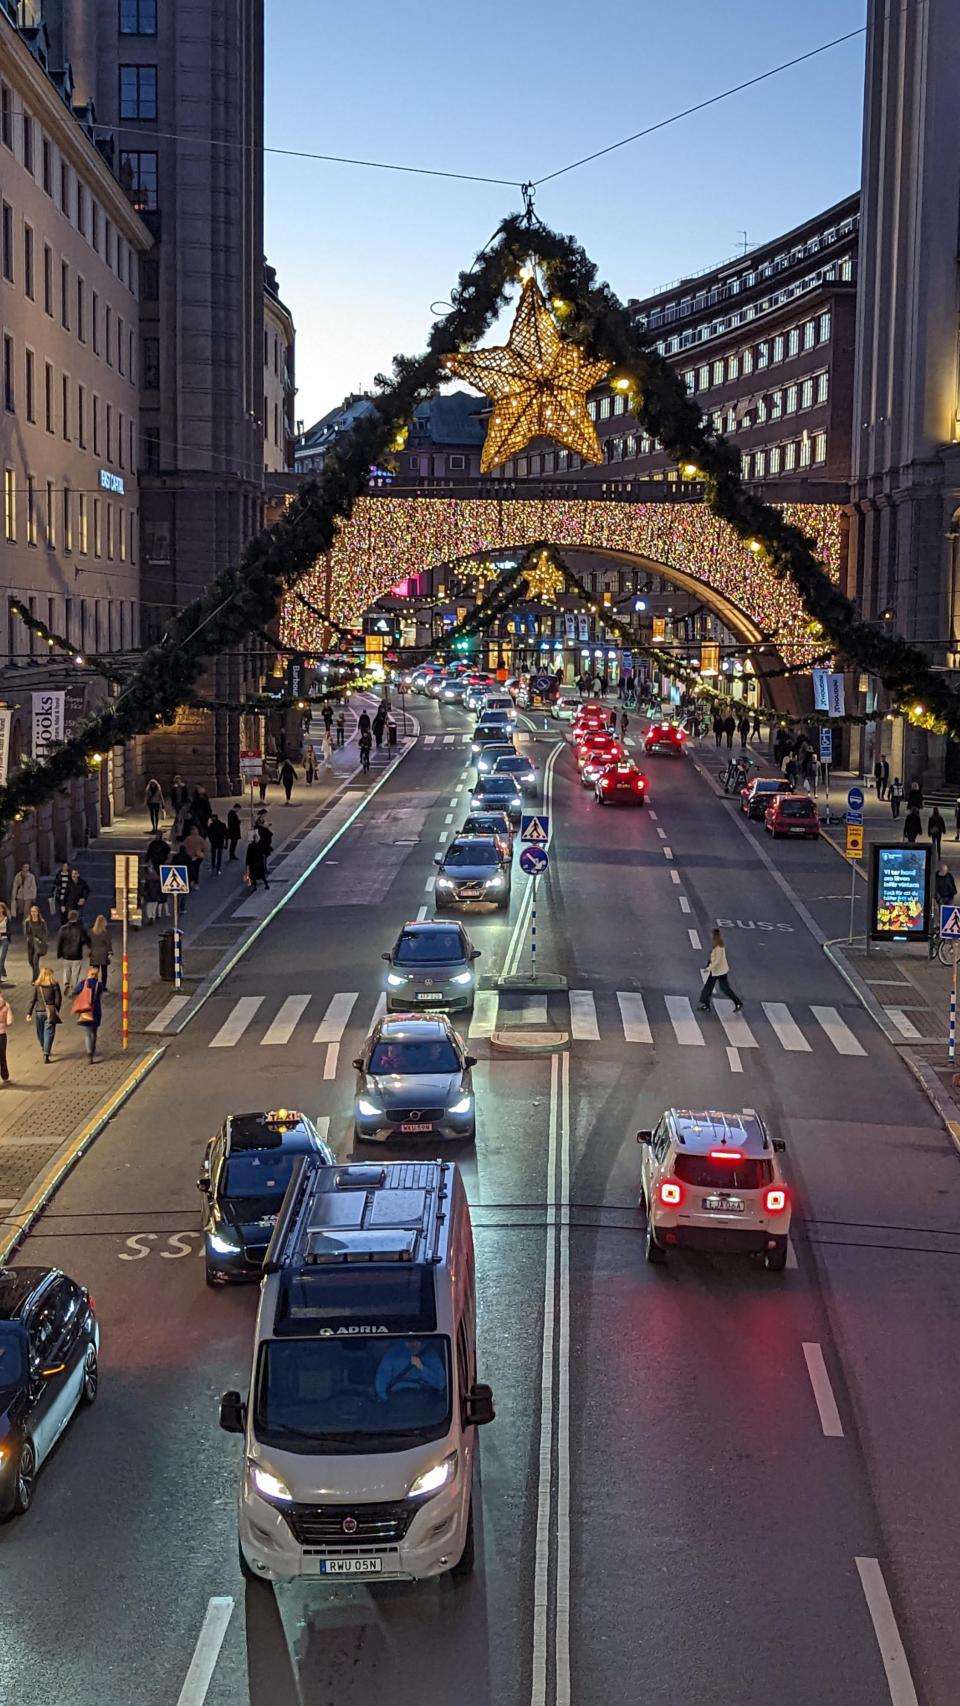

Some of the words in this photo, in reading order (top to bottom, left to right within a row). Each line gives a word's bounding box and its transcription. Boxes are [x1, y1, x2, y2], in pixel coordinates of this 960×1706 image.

[292, 665, 300, 697] Barbour
[716, 919, 794, 932] BUSS
[336, 1325, 389, 1334] ADRIA
[329, 1561, 351, 1572] RWU
[354, 1560, 377, 1570] 05N
